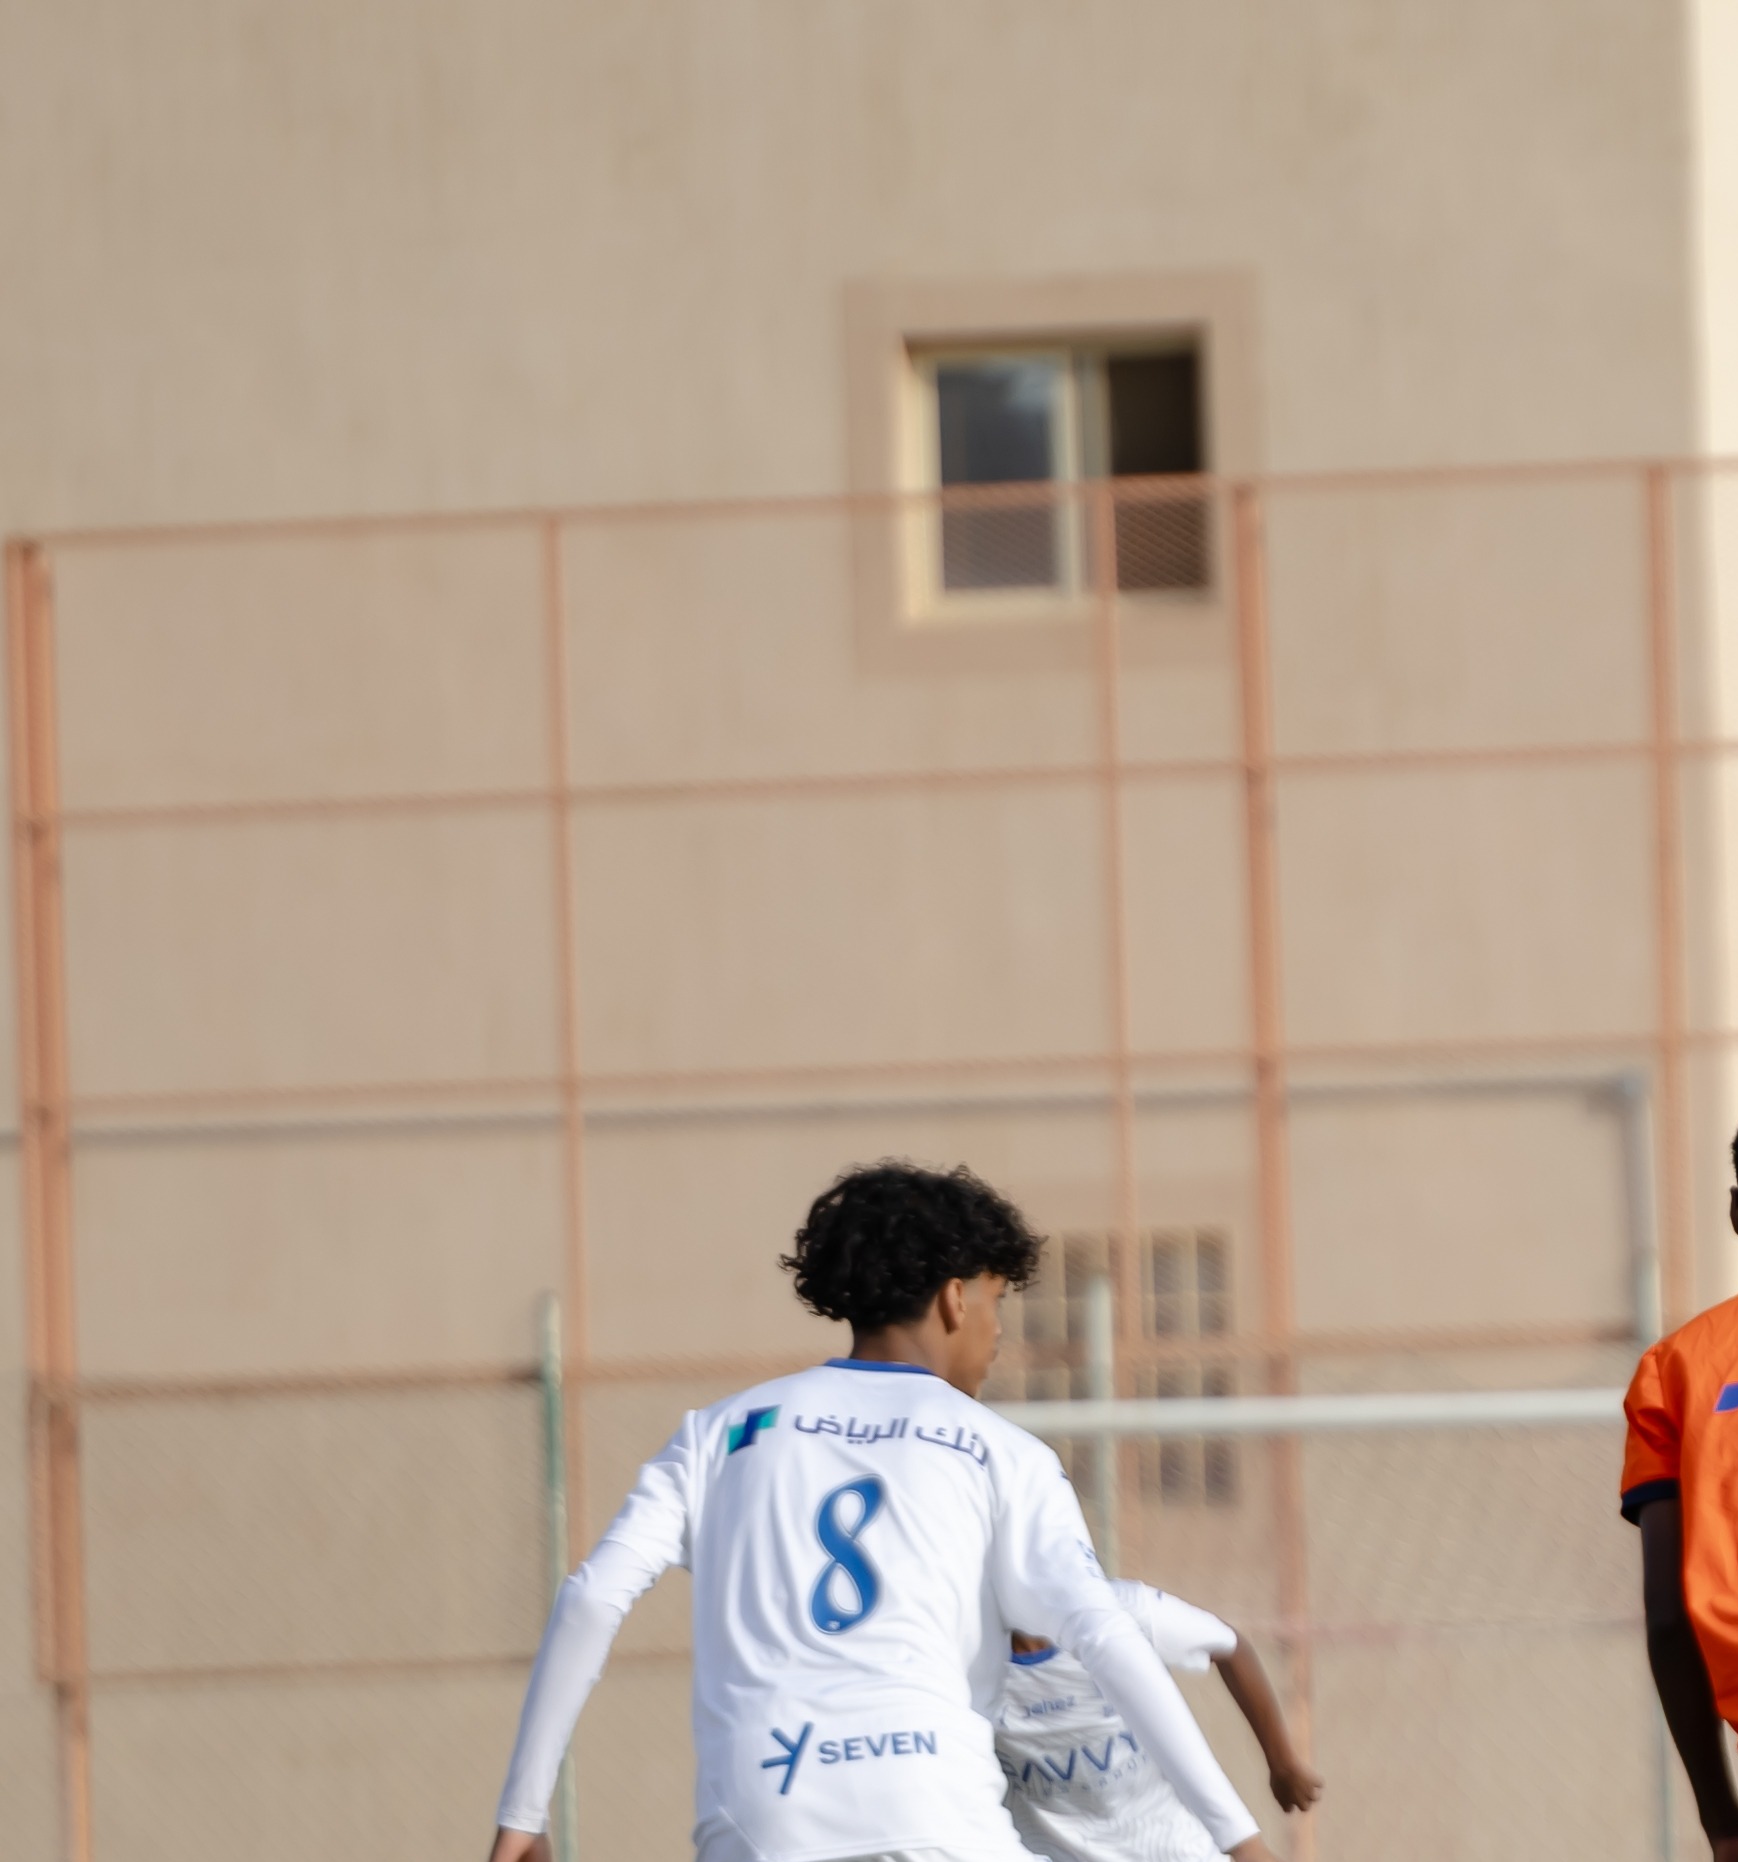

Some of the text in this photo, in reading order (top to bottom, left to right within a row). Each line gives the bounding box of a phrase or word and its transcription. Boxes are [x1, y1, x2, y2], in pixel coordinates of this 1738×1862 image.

[793, 1413, 989, 1471] بنك الرياض
[808, 1472, 888, 1635] 8
[818, 1730, 938, 1765] SEVEN
